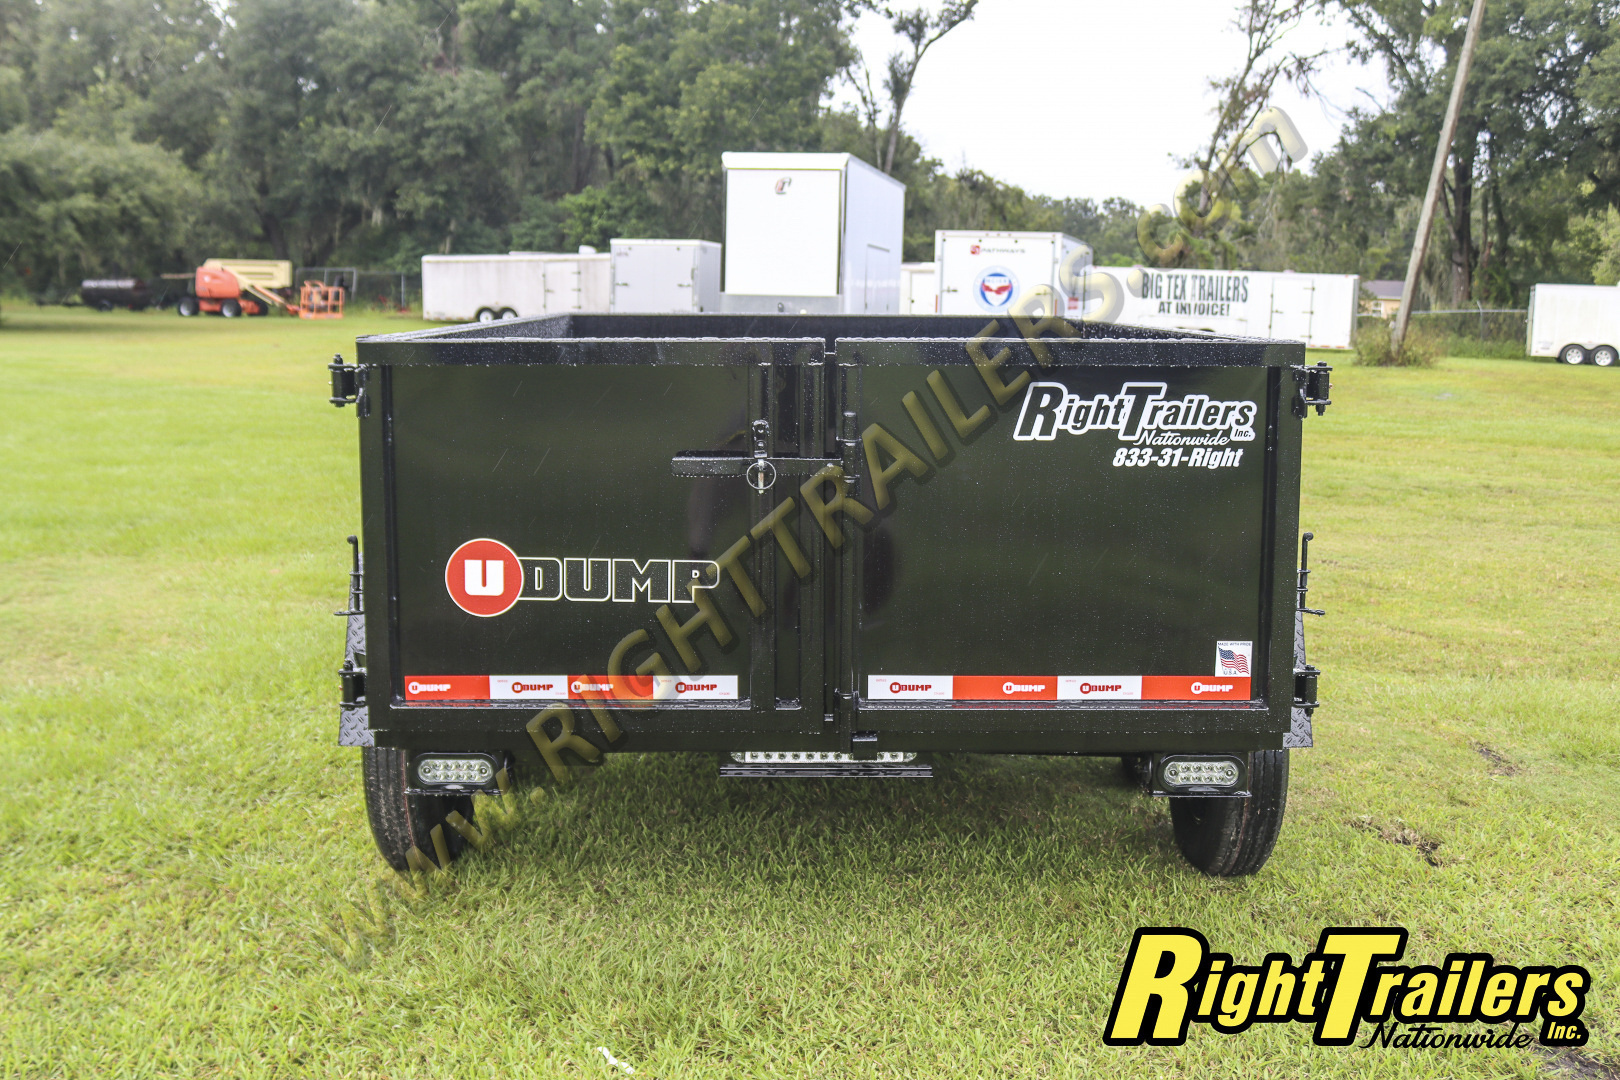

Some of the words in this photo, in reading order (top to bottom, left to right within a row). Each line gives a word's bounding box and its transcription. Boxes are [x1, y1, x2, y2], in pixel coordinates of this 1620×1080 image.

[1142, 272, 1163, 299] BIG
[1167, 274, 1187, 300] TEX
[1191, 274, 1249, 303] TRAILERS
[1158, 302, 1172, 314] AT
[1133, 430, 1230, 447] Nationwide
[1234, 428, 1252, 438] Inc.
[1112, 447, 1244, 470] 833-31-Right
